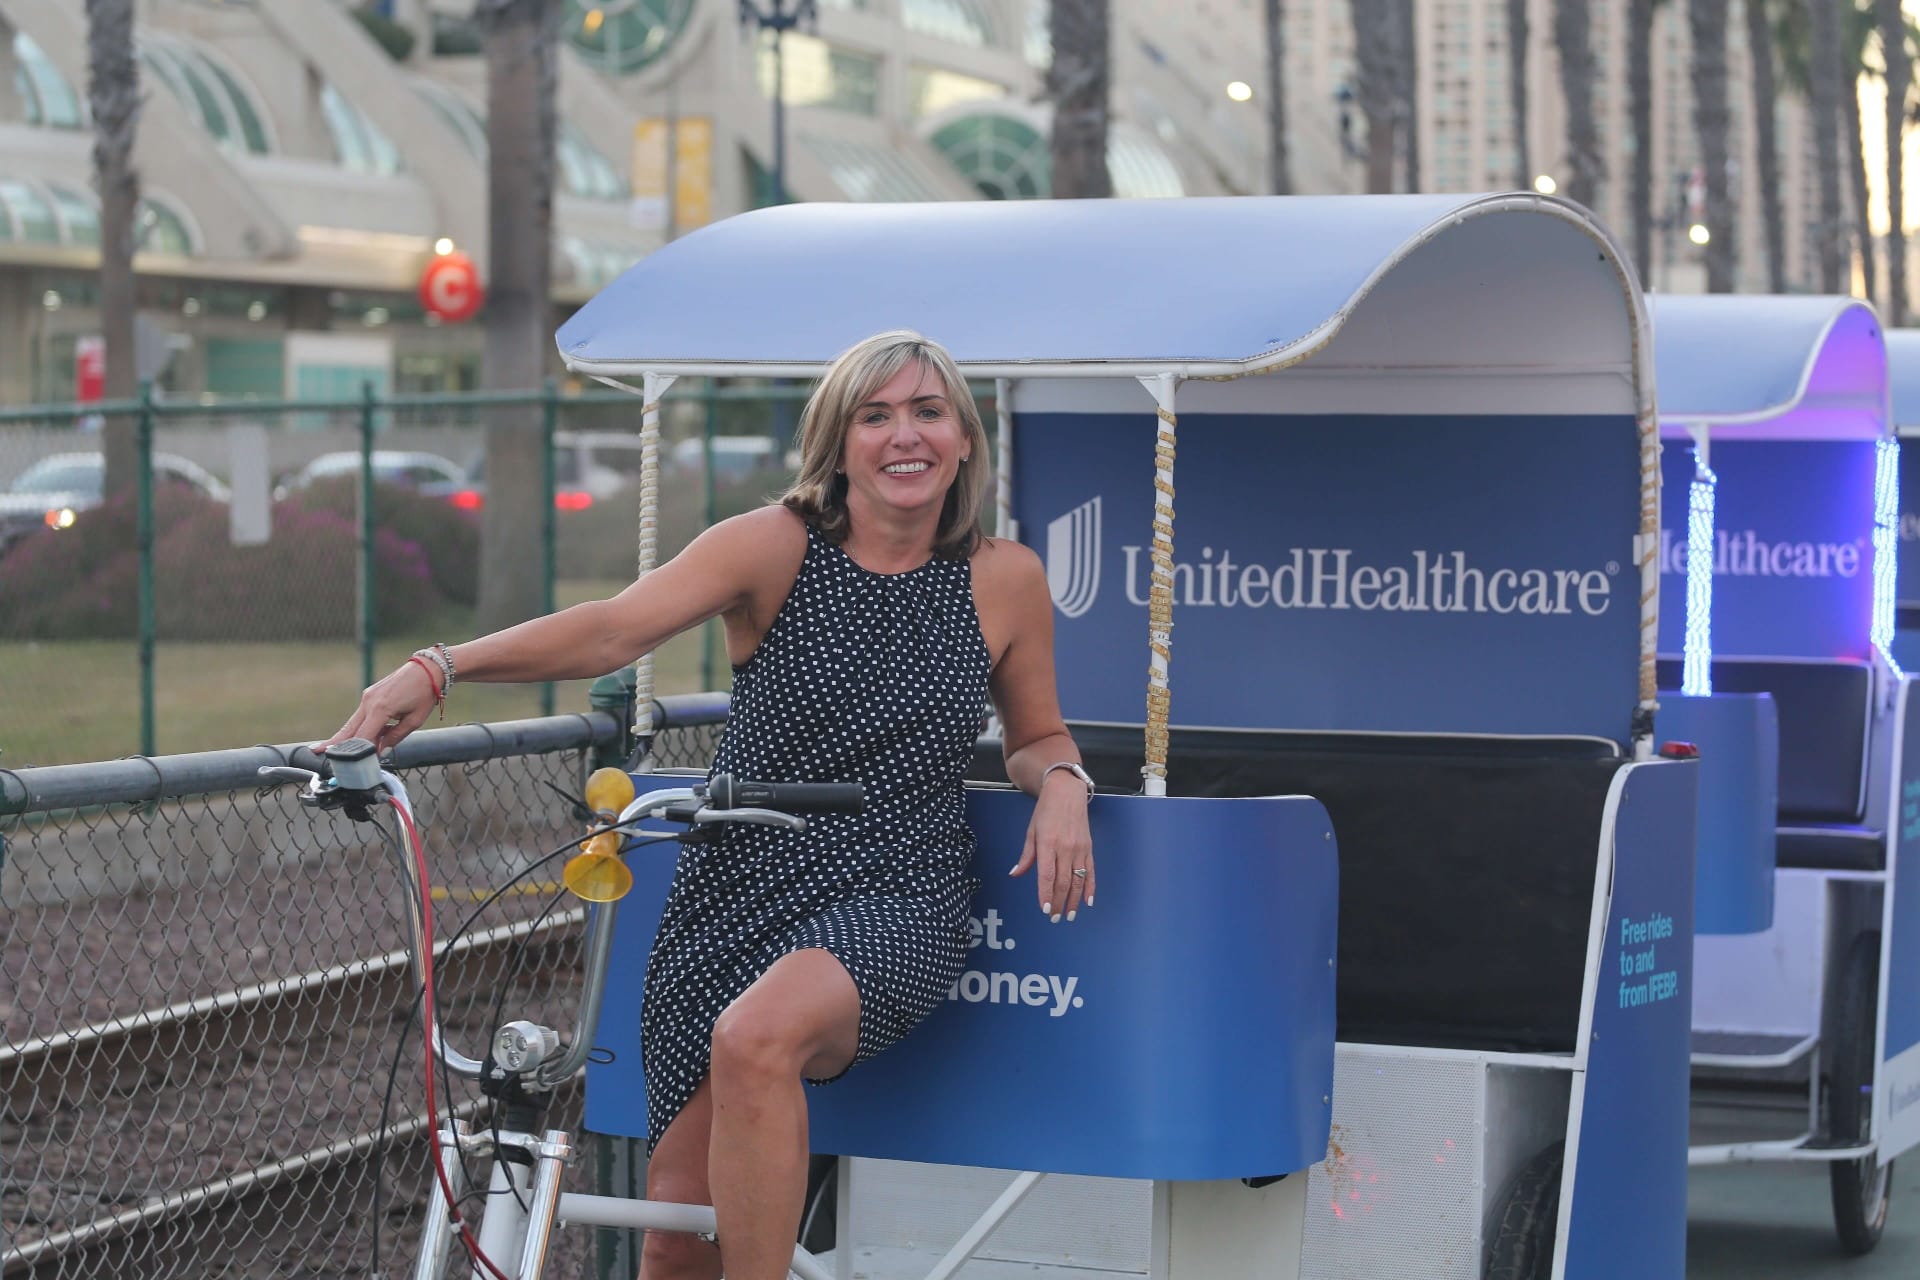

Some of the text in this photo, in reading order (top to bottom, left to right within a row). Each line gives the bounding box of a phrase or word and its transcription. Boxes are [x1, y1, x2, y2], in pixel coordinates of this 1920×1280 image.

[432, 267, 468, 311] C
[1621, 911, 1673, 946] Free rides
[1620, 943, 1655, 976] to and
[1619, 970, 1679, 1009] from IFEBP.
